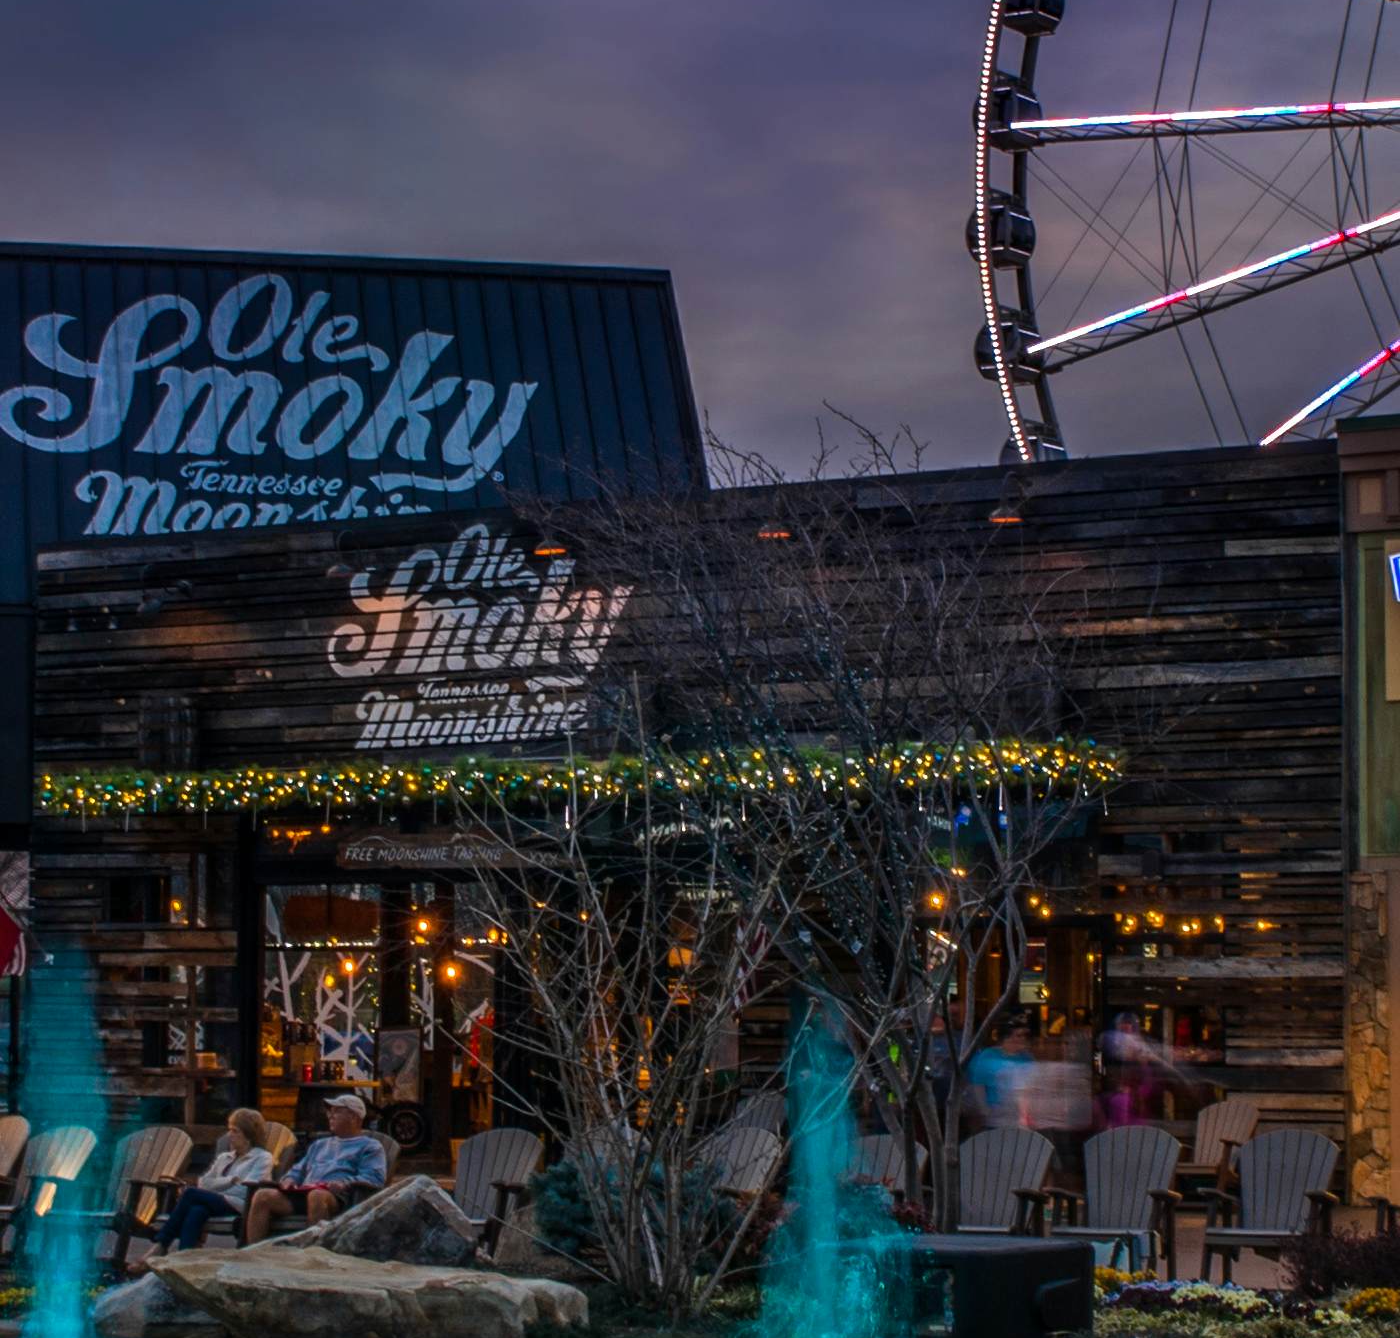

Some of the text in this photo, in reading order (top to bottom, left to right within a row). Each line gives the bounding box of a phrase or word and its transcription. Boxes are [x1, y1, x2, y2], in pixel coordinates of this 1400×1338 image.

[209, 273, 389, 371] Ole
[0, 294, 538, 491] Smoky
[74, 470, 432, 535] Moonshi
[180, 461, 343, 496] Tennessee
[443, 523, 540, 592] Ole
[328, 549, 635, 692] Smoky
[354, 691, 588, 749] Moonshine
[418, 677, 510, 705] Tennessee
[345, 847, 374, 861] FREE
[377, 846, 449, 861] MOONSHINE
